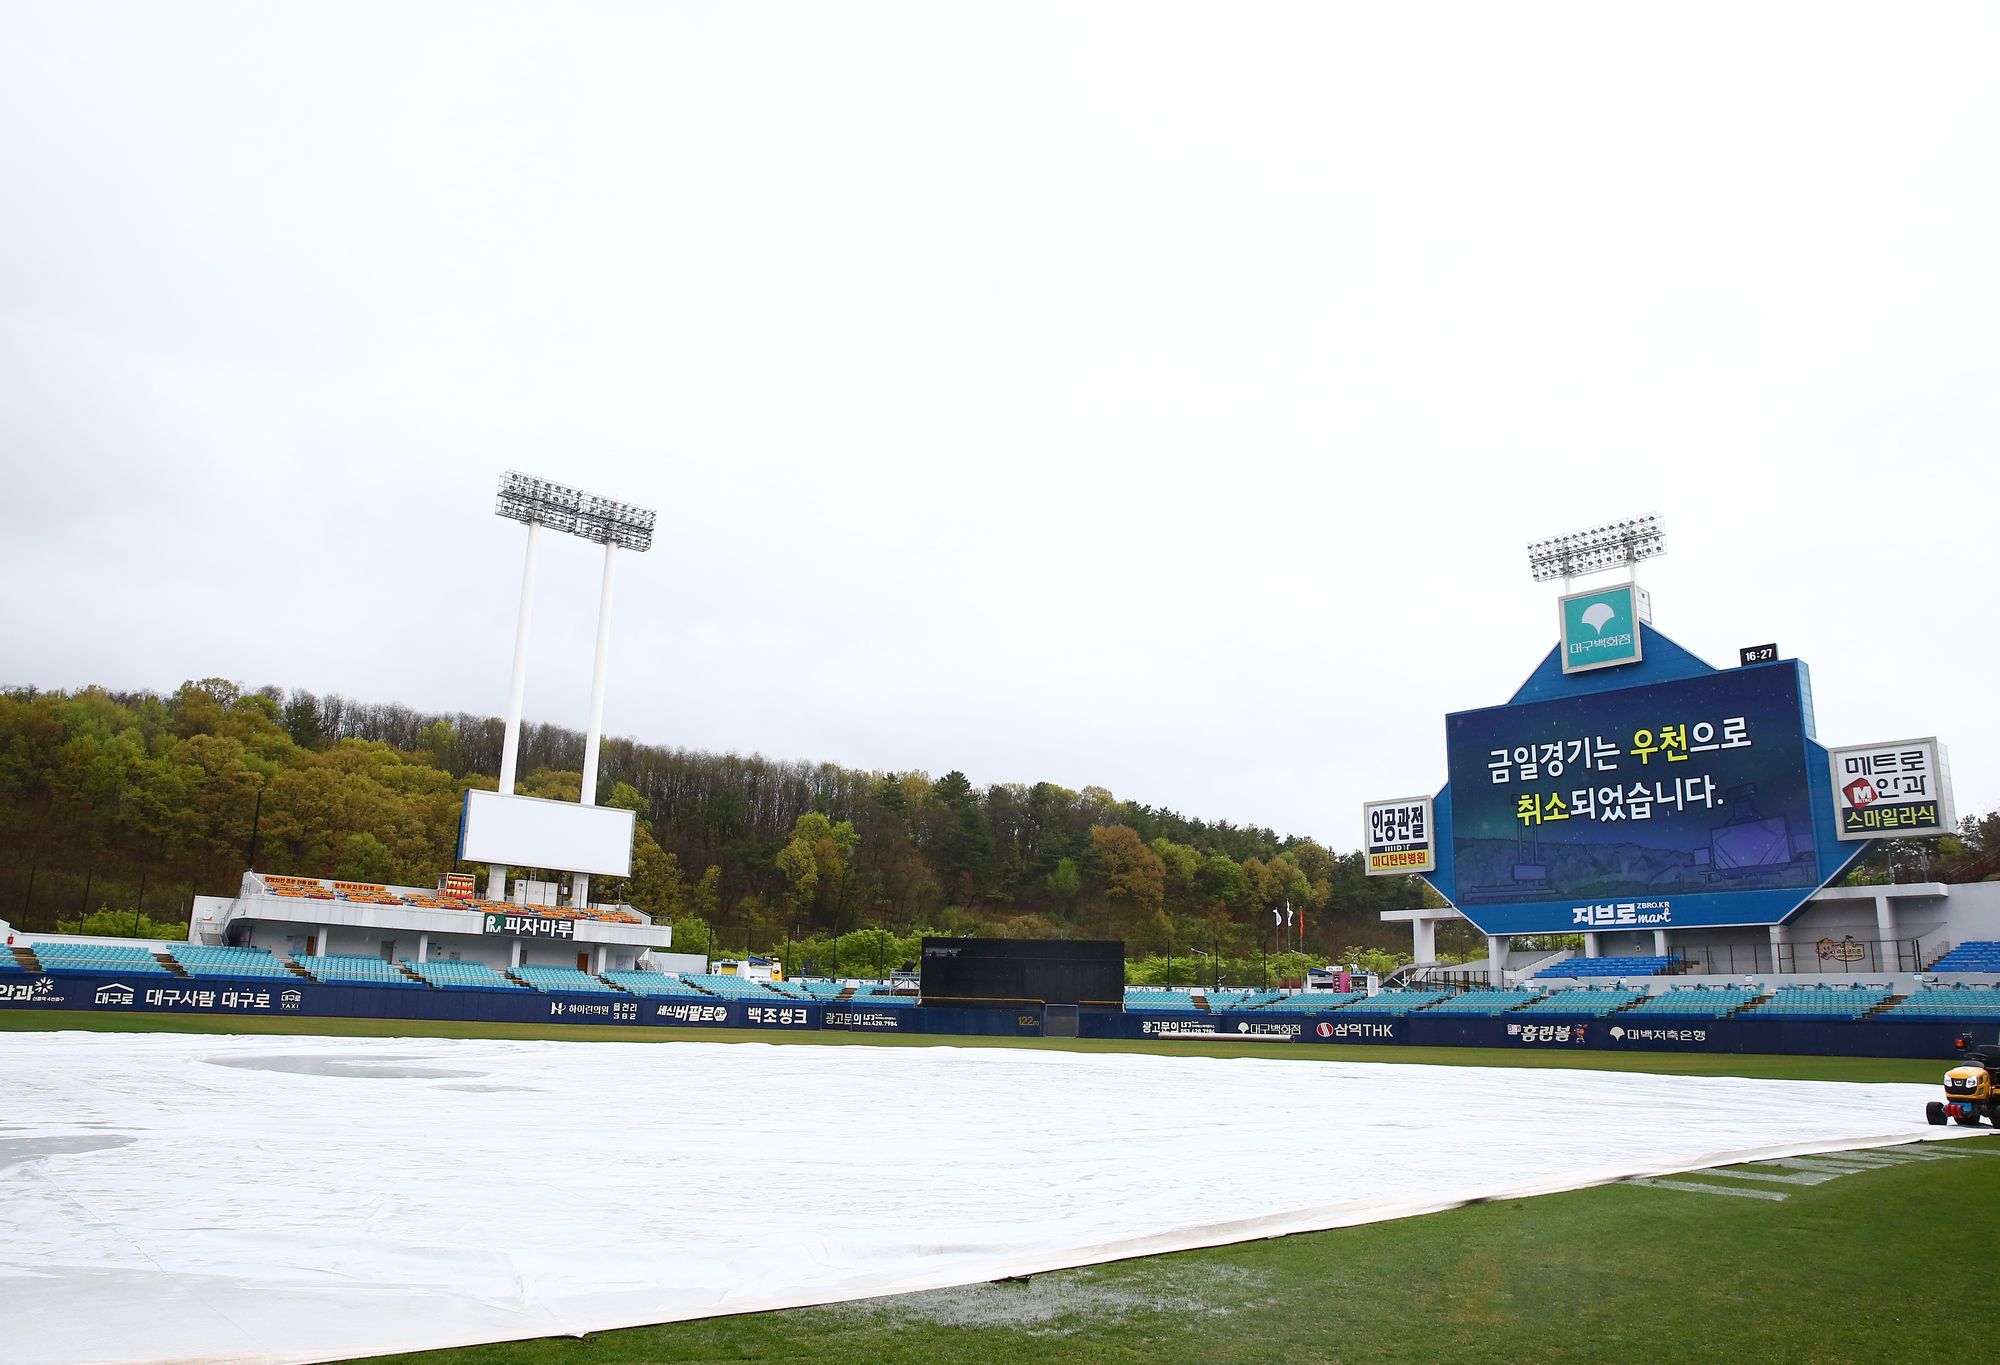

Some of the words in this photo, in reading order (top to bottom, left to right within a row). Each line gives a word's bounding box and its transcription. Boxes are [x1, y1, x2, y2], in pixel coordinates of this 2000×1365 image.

[1569, 633, 1631, 654] 대구백화점
[1745, 648, 1773, 661] 16:27
[1487, 736, 1620, 784] 금일경기는
[1630, 716, 1752, 764] 우천으로
[1845, 750, 1926, 776] 메트로
[1876, 775, 1926, 799] 안과
[1516, 774, 1724, 826] 취소되었습니다.
[1372, 805, 1424, 843] 인공관절
[1847, 806, 1936, 829] 스마일라식
[1372, 852, 1426, 867] 마디탄탄병원
[447, 880, 473, 890] TTANG
[446, 889, 473, 899] TTANG
[1636, 901, 1670, 909] ZBRO.KR
[1572, 903, 1637, 925] 지브로
[1638, 908, 1671, 924] mart
[504, 916, 573, 938] 피자마루
[0, 984, 34, 1001] 안과
[95, 992, 134, 1005] 대구로
[145, 989, 216, 1007] 대구사람
[221, 991, 271, 1008] 대구로
[281, 994, 301, 1002] 대구로
[568, 1004, 609, 1016] 하이린의원
[613, 1012, 636, 1020] 382
[656, 1004, 715, 1022] 세신버팔로
[748, 1007, 807, 1025] 백조씽크
[825, 1012, 862, 1027] 광고문의
[1017, 1016, 1039, 1026] 122m
[1142, 1021, 1179, 1033] 광고문의
[1250, 1024, 1301, 1035] 대구백화점
[1334, 1023, 1394, 1037] 삼익THK
[1521, 1024, 1571, 1043] 홈런볼
[1627, 1029, 1706, 1041] 대백저축은행
